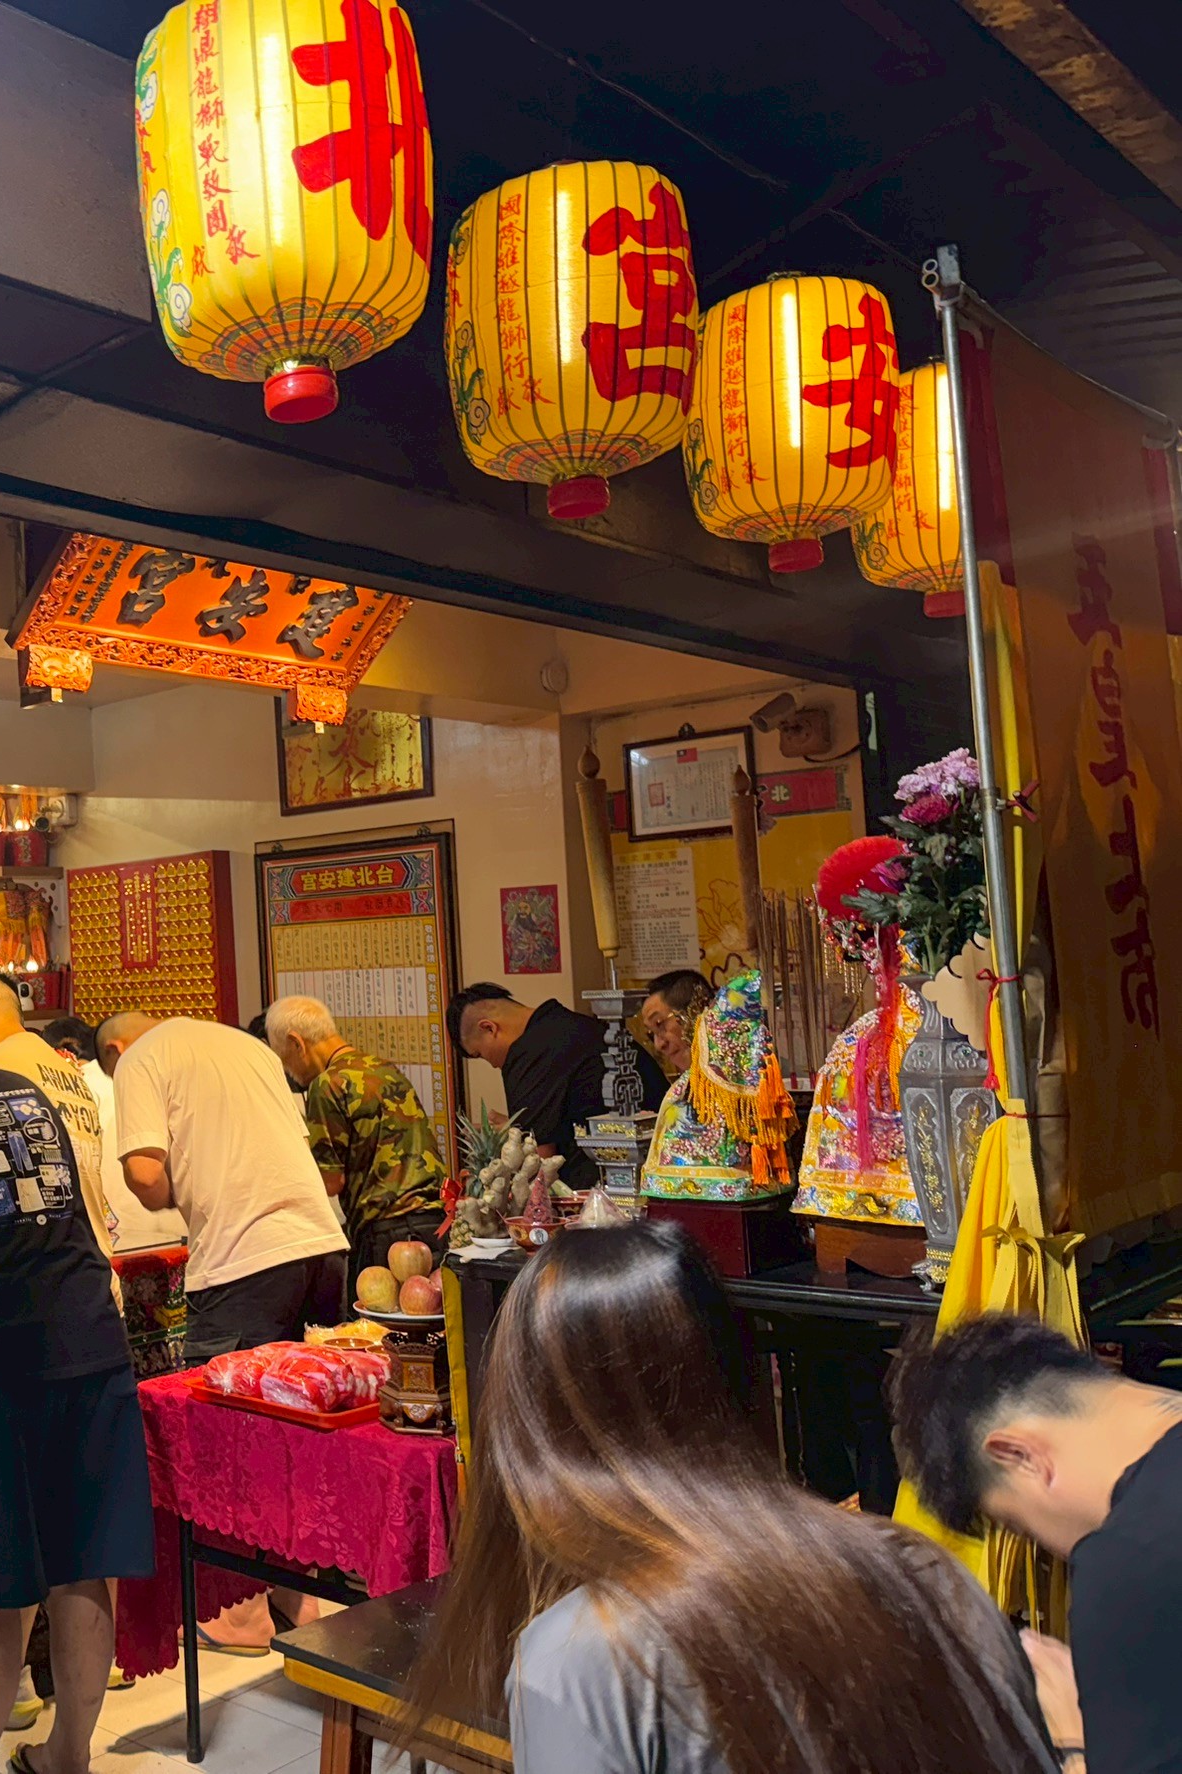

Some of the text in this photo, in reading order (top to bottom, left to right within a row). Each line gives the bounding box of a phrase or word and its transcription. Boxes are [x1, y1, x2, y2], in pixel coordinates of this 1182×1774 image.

[300, 865, 395, 892] 台北建安宮
